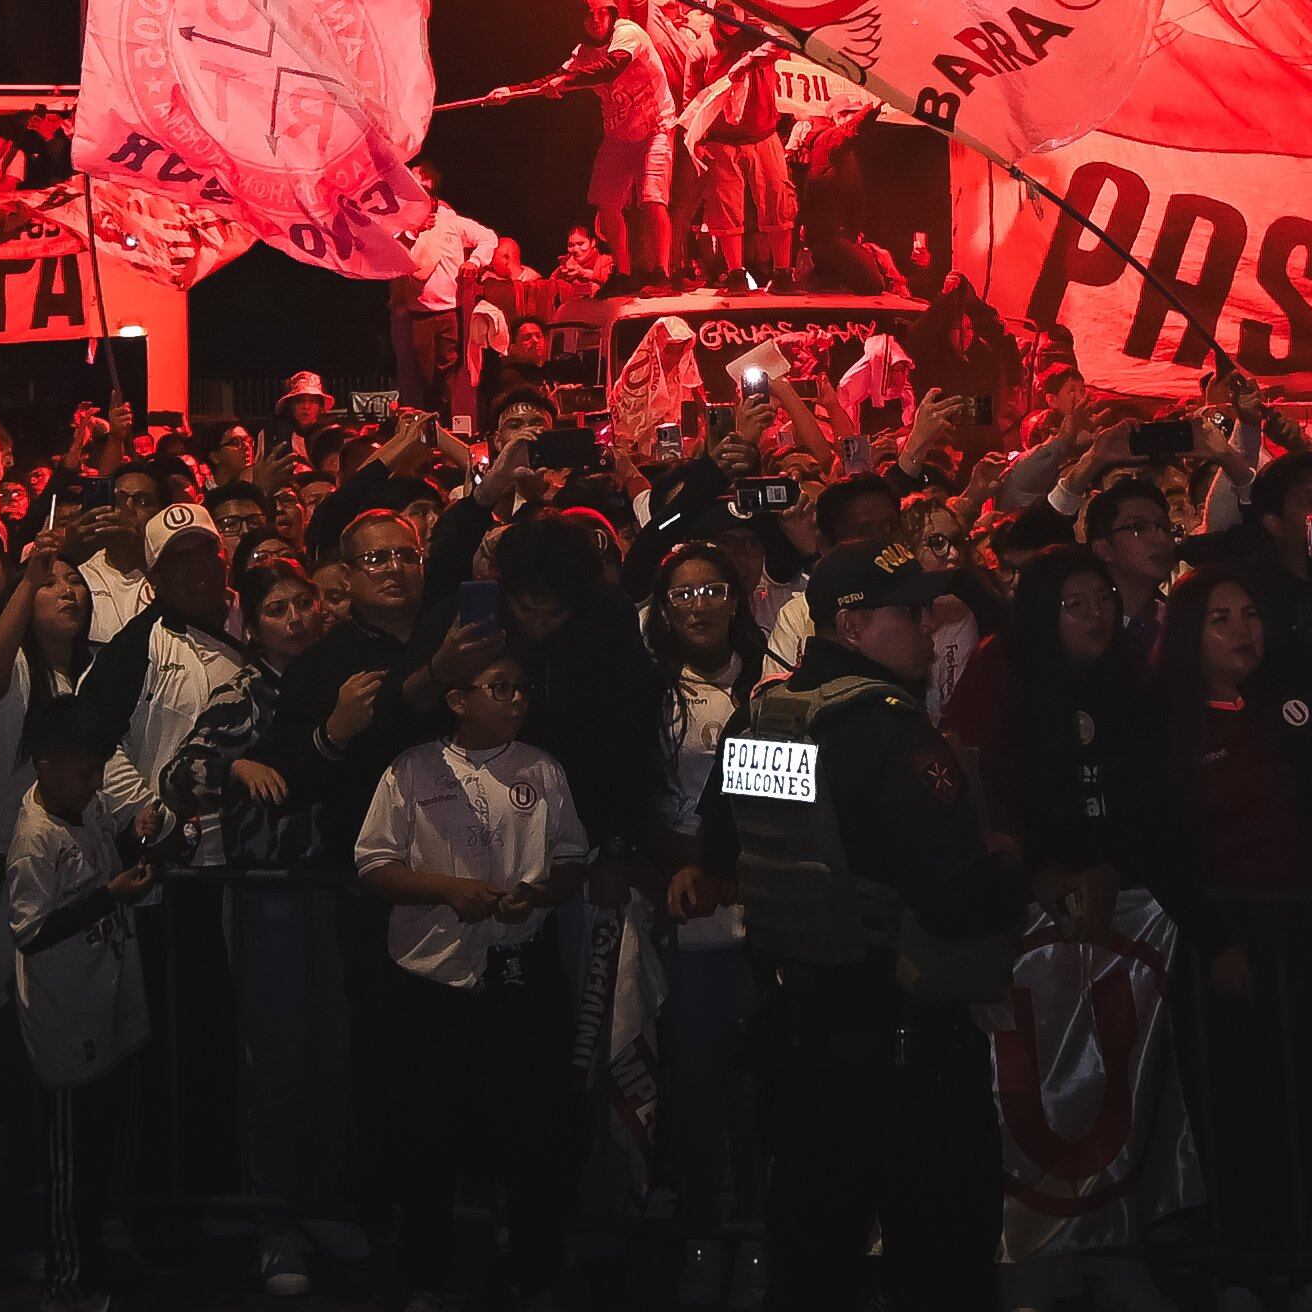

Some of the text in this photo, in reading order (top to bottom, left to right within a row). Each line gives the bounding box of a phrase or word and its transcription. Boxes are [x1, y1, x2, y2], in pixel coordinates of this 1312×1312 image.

[912, 7, 1074, 133] BARRA
[700, 319, 793, 350] GRUAS
[727, 742, 810, 775] POLICIA
[725, 770, 811, 797] HALCONES
